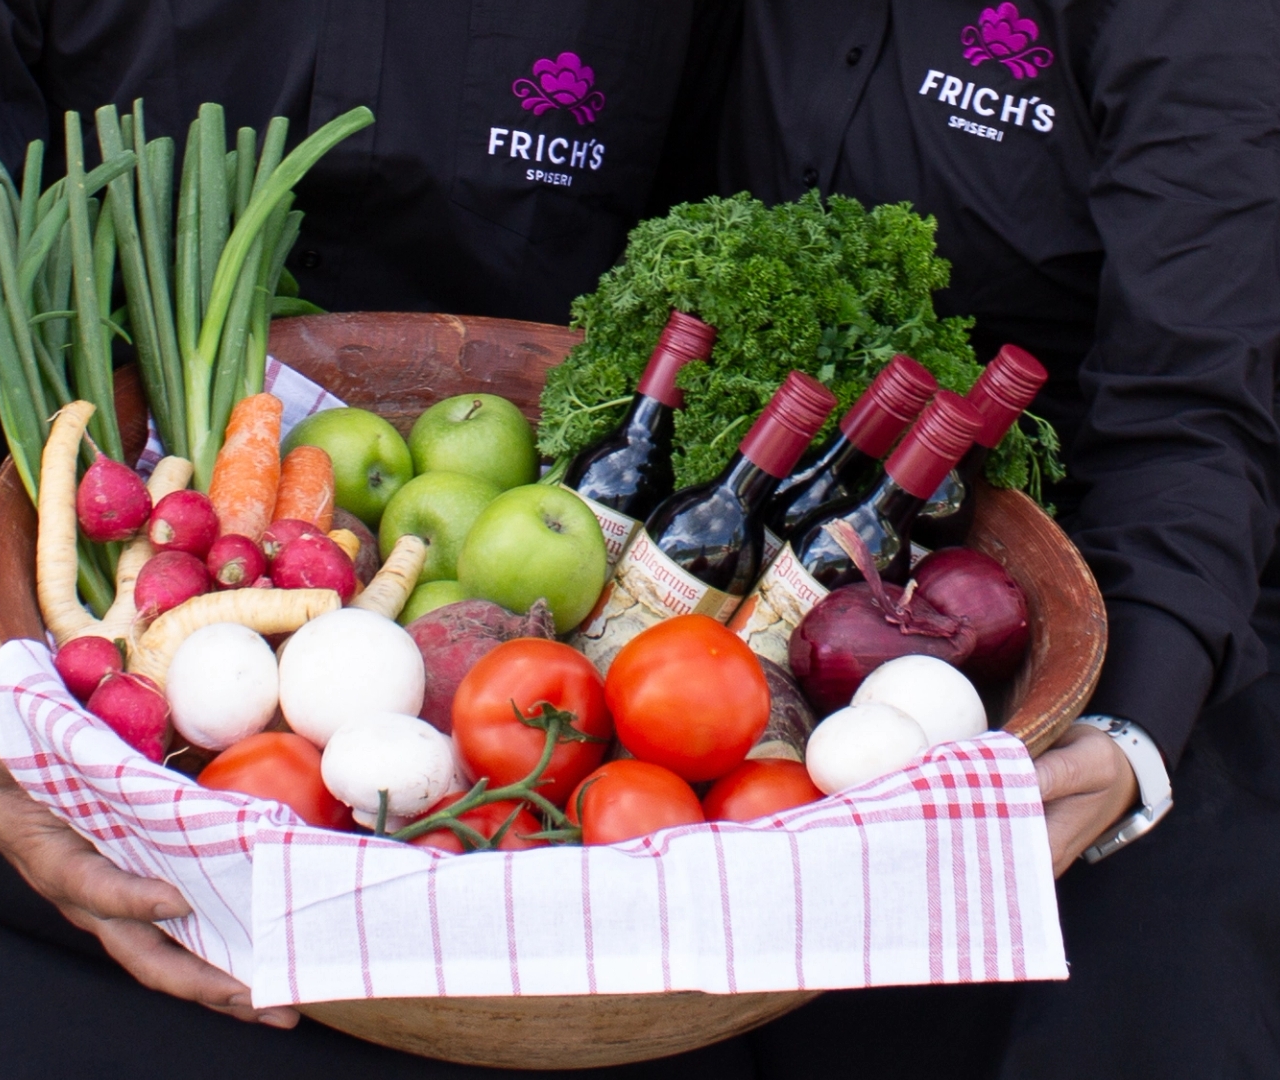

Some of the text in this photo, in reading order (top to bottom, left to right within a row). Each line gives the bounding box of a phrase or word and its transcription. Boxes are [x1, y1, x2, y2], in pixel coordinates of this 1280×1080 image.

[918, 69, 1056, 133] FRICH'S
[948, 115, 1004, 142] SPISERI
[488, 127, 605, 170] FRICH'S
[526, 169, 572, 186] SPISERI
